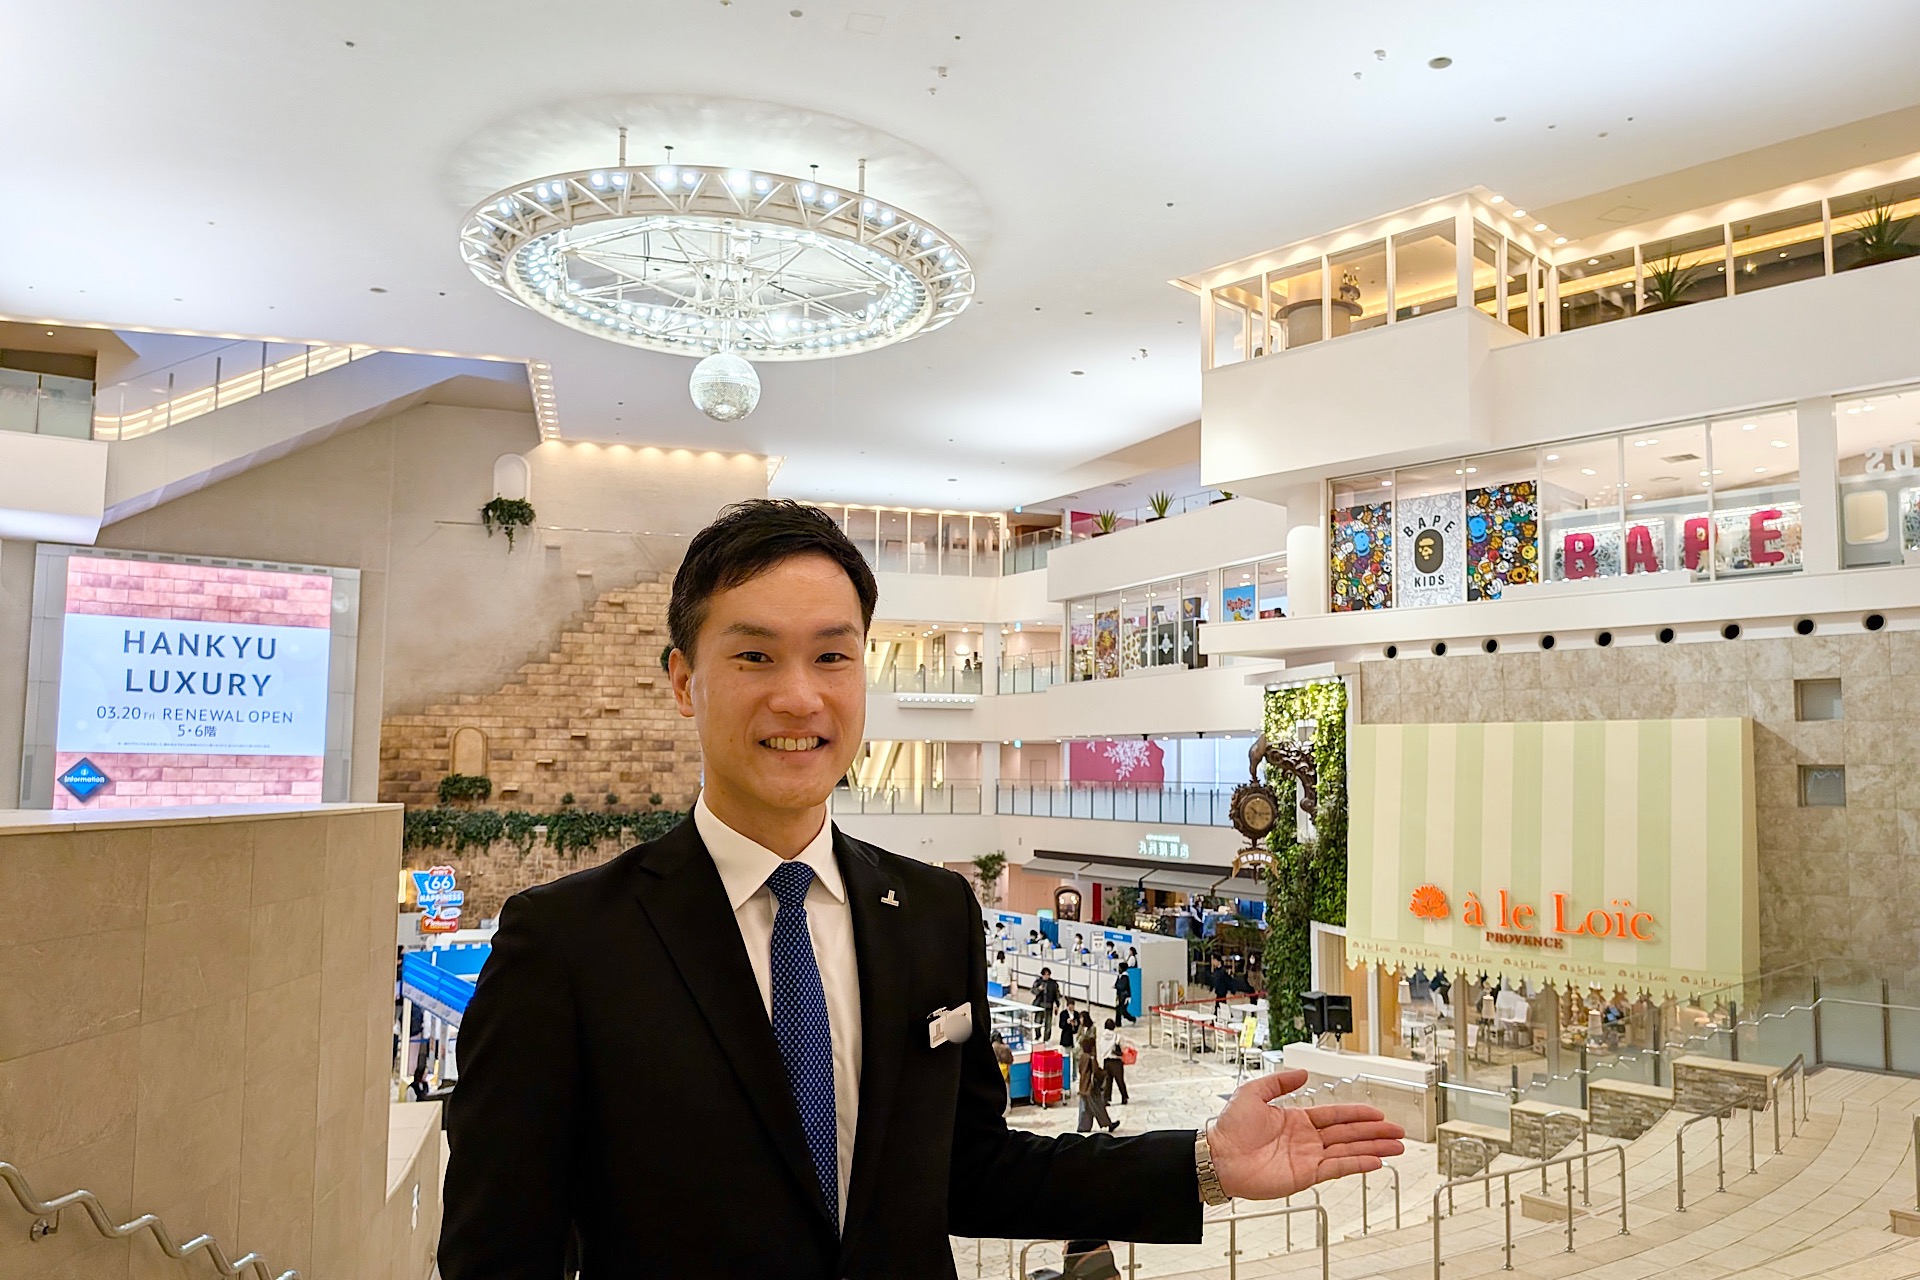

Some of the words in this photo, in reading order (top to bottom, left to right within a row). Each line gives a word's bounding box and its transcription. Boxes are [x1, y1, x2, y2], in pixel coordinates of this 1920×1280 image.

[1403, 515, 1456, 537] BAPE
[1564, 510, 1785, 579] BAPE
[1414, 574, 1445, 588] KIDS
[123, 629, 277, 660] HANKYU
[125, 668, 272, 697] LUXURY
[96, 705, 142, 720] 03.20
[143, 711, 155, 720] Fri
[162, 707, 244, 723] RENEWAL
[248, 709, 294, 724] OPEN
[64, 775, 105, 784] Information
[431, 876, 451, 890] 66
[1463, 891, 1485, 927] à
[1499, 889, 1534, 931] le
[1551, 892, 1655, 941] Loïc
[1485, 932, 1564, 949] PROVENCE
